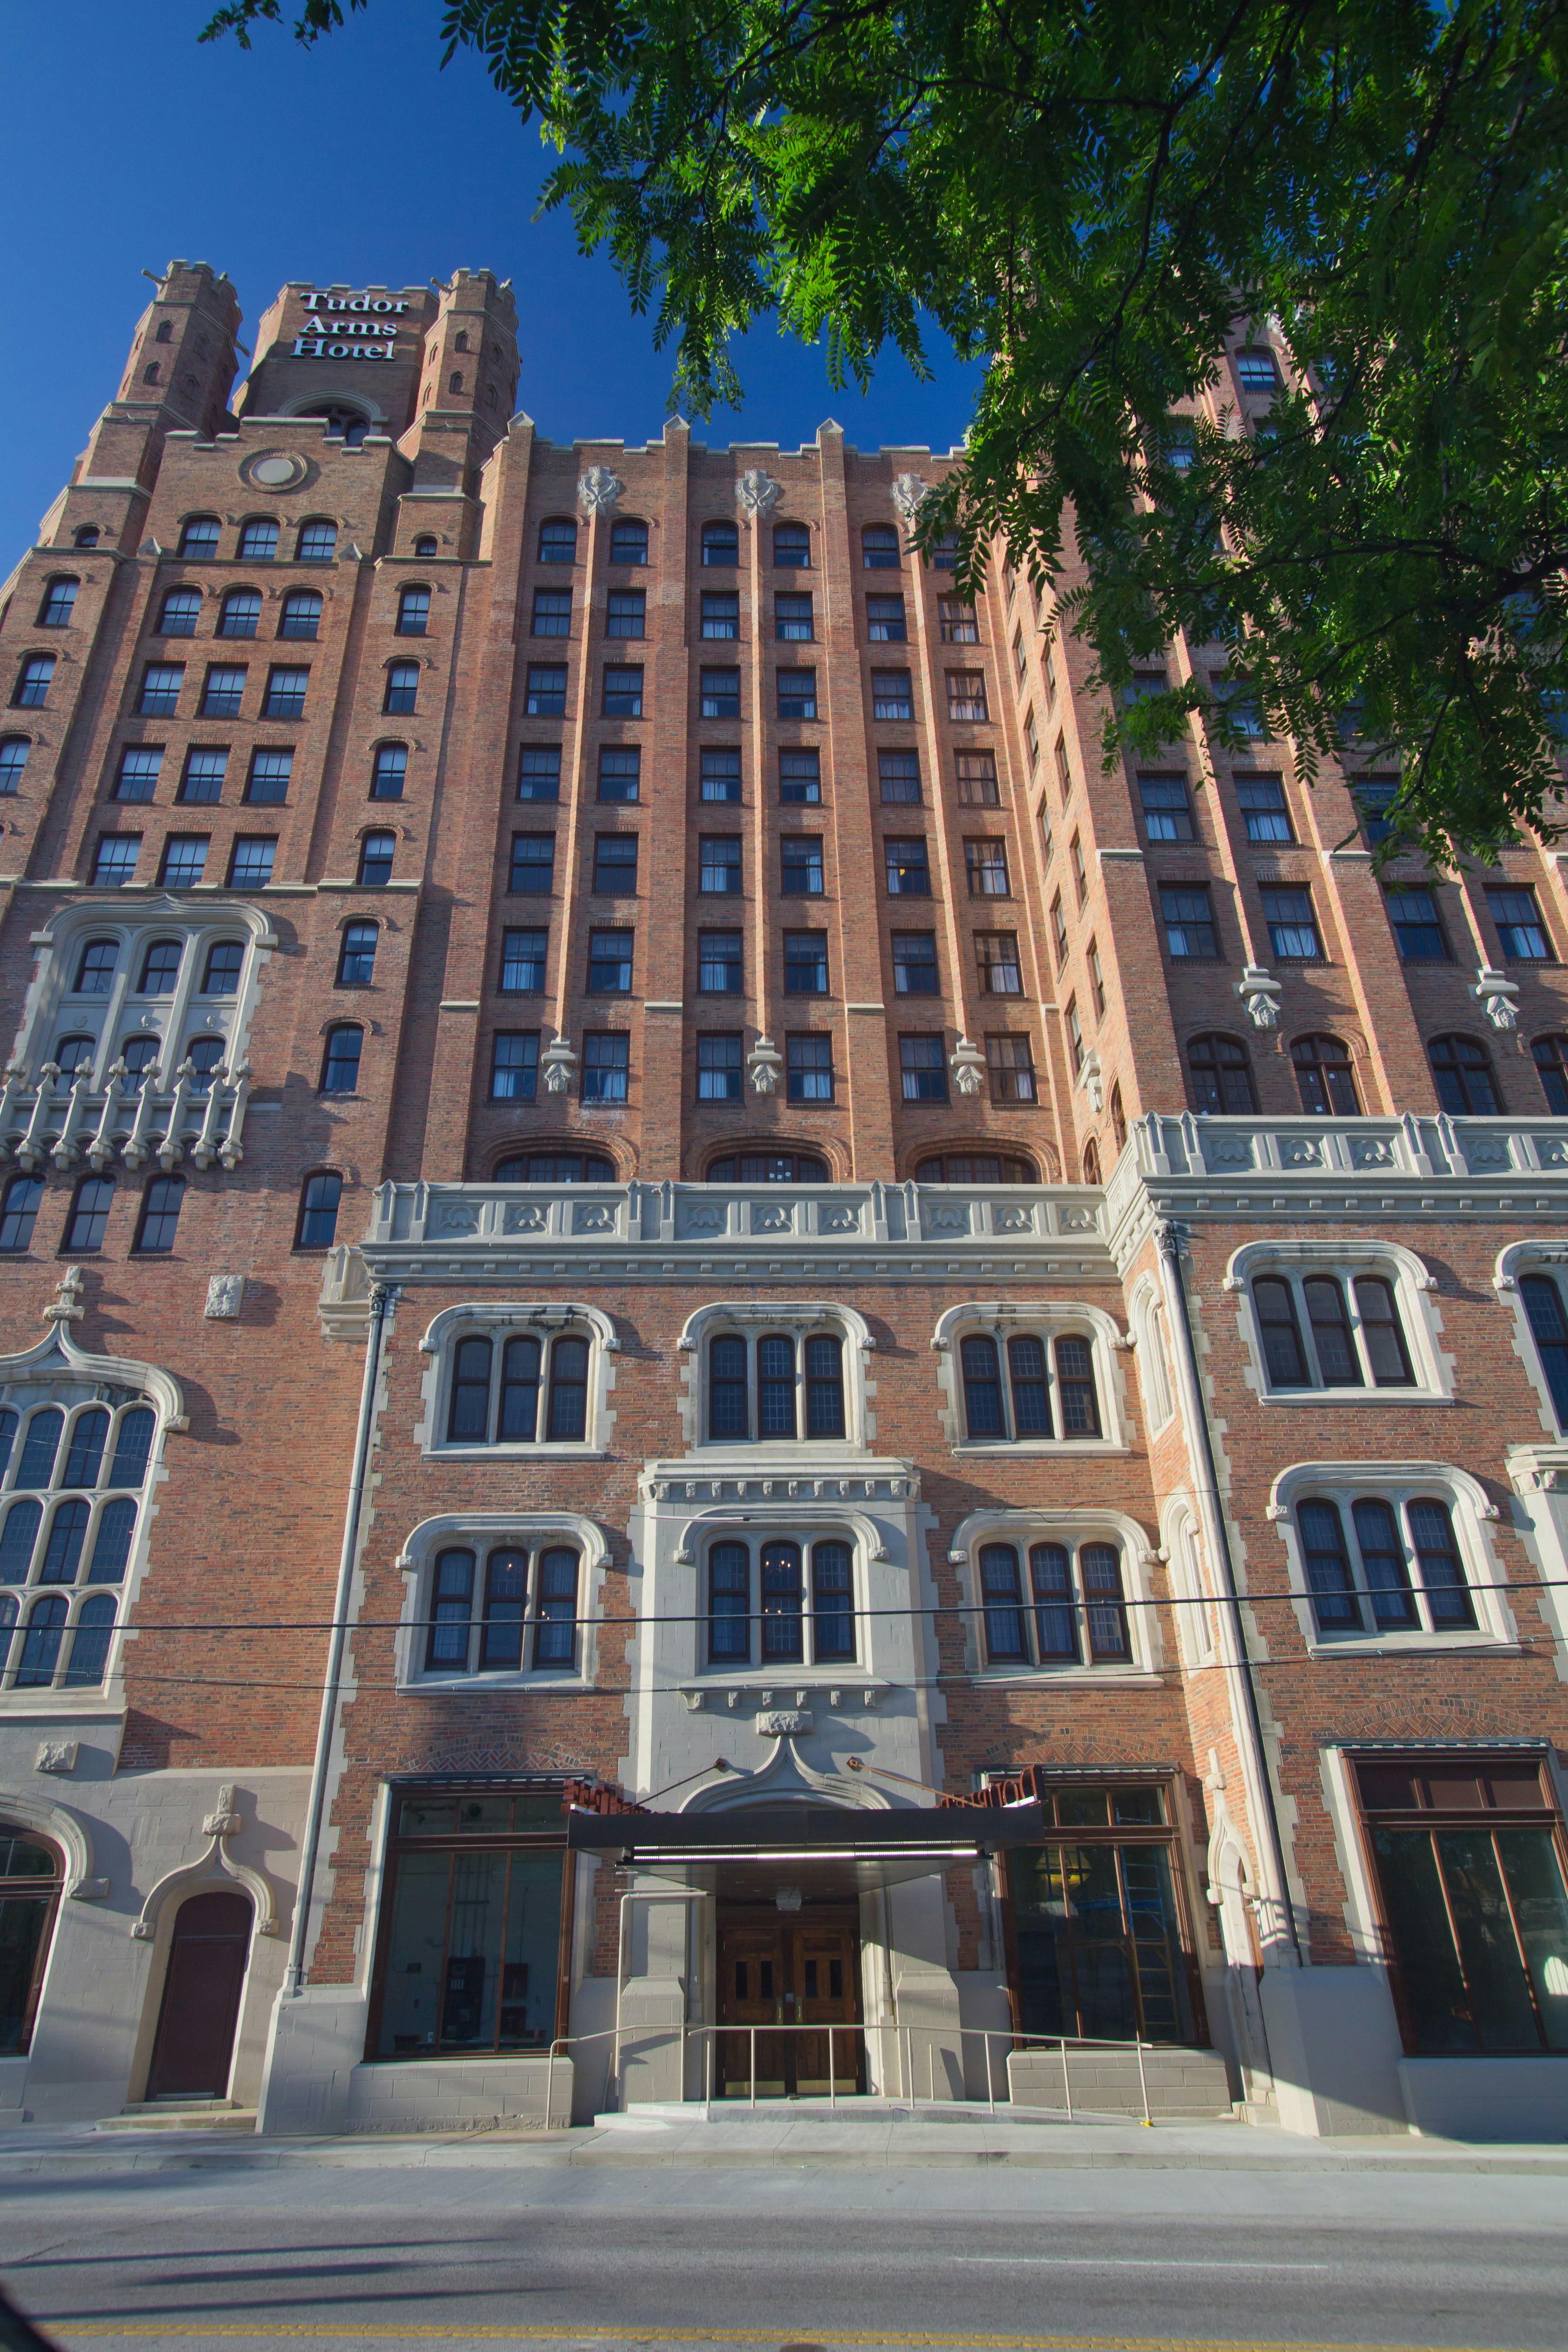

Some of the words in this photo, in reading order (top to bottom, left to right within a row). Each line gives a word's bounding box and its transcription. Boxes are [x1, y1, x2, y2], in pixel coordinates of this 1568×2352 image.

[300, 292, 409, 313] Tudor
[298, 315, 397, 336] Arms
[290, 338, 395, 359] Hotel
